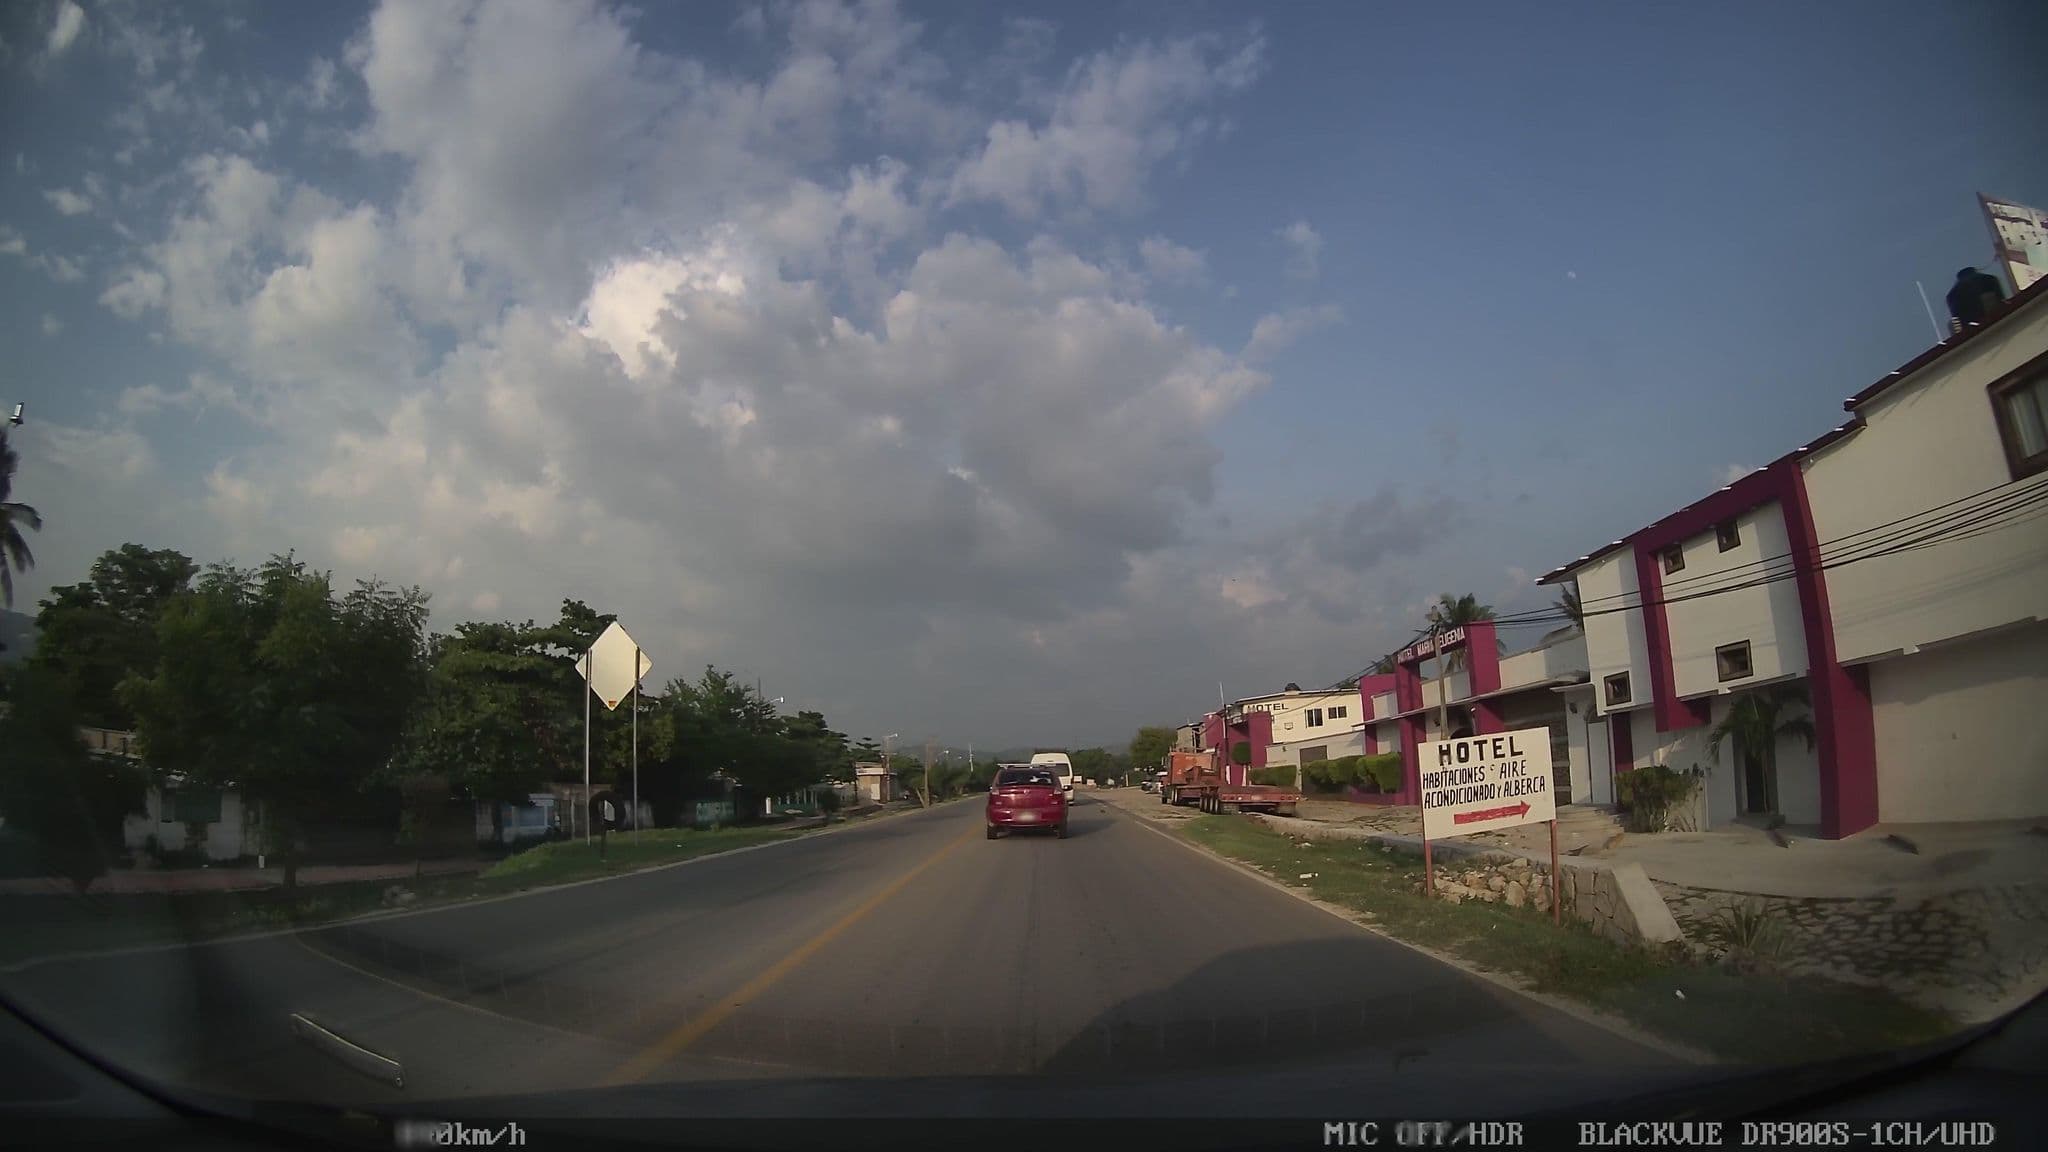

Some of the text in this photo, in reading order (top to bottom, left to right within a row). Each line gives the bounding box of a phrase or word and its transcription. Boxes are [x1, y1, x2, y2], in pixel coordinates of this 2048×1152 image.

[1247, 703, 1289, 712] HOTEL
[1438, 736, 1524, 766] HOTEL
[1423, 766, 1485, 790] HABITACIONES
[1500, 760, 1527, 779] AIRE
[1424, 783, 1495, 809] ACONDICIONADO
[1503, 775, 1546, 798] ALBERCA
